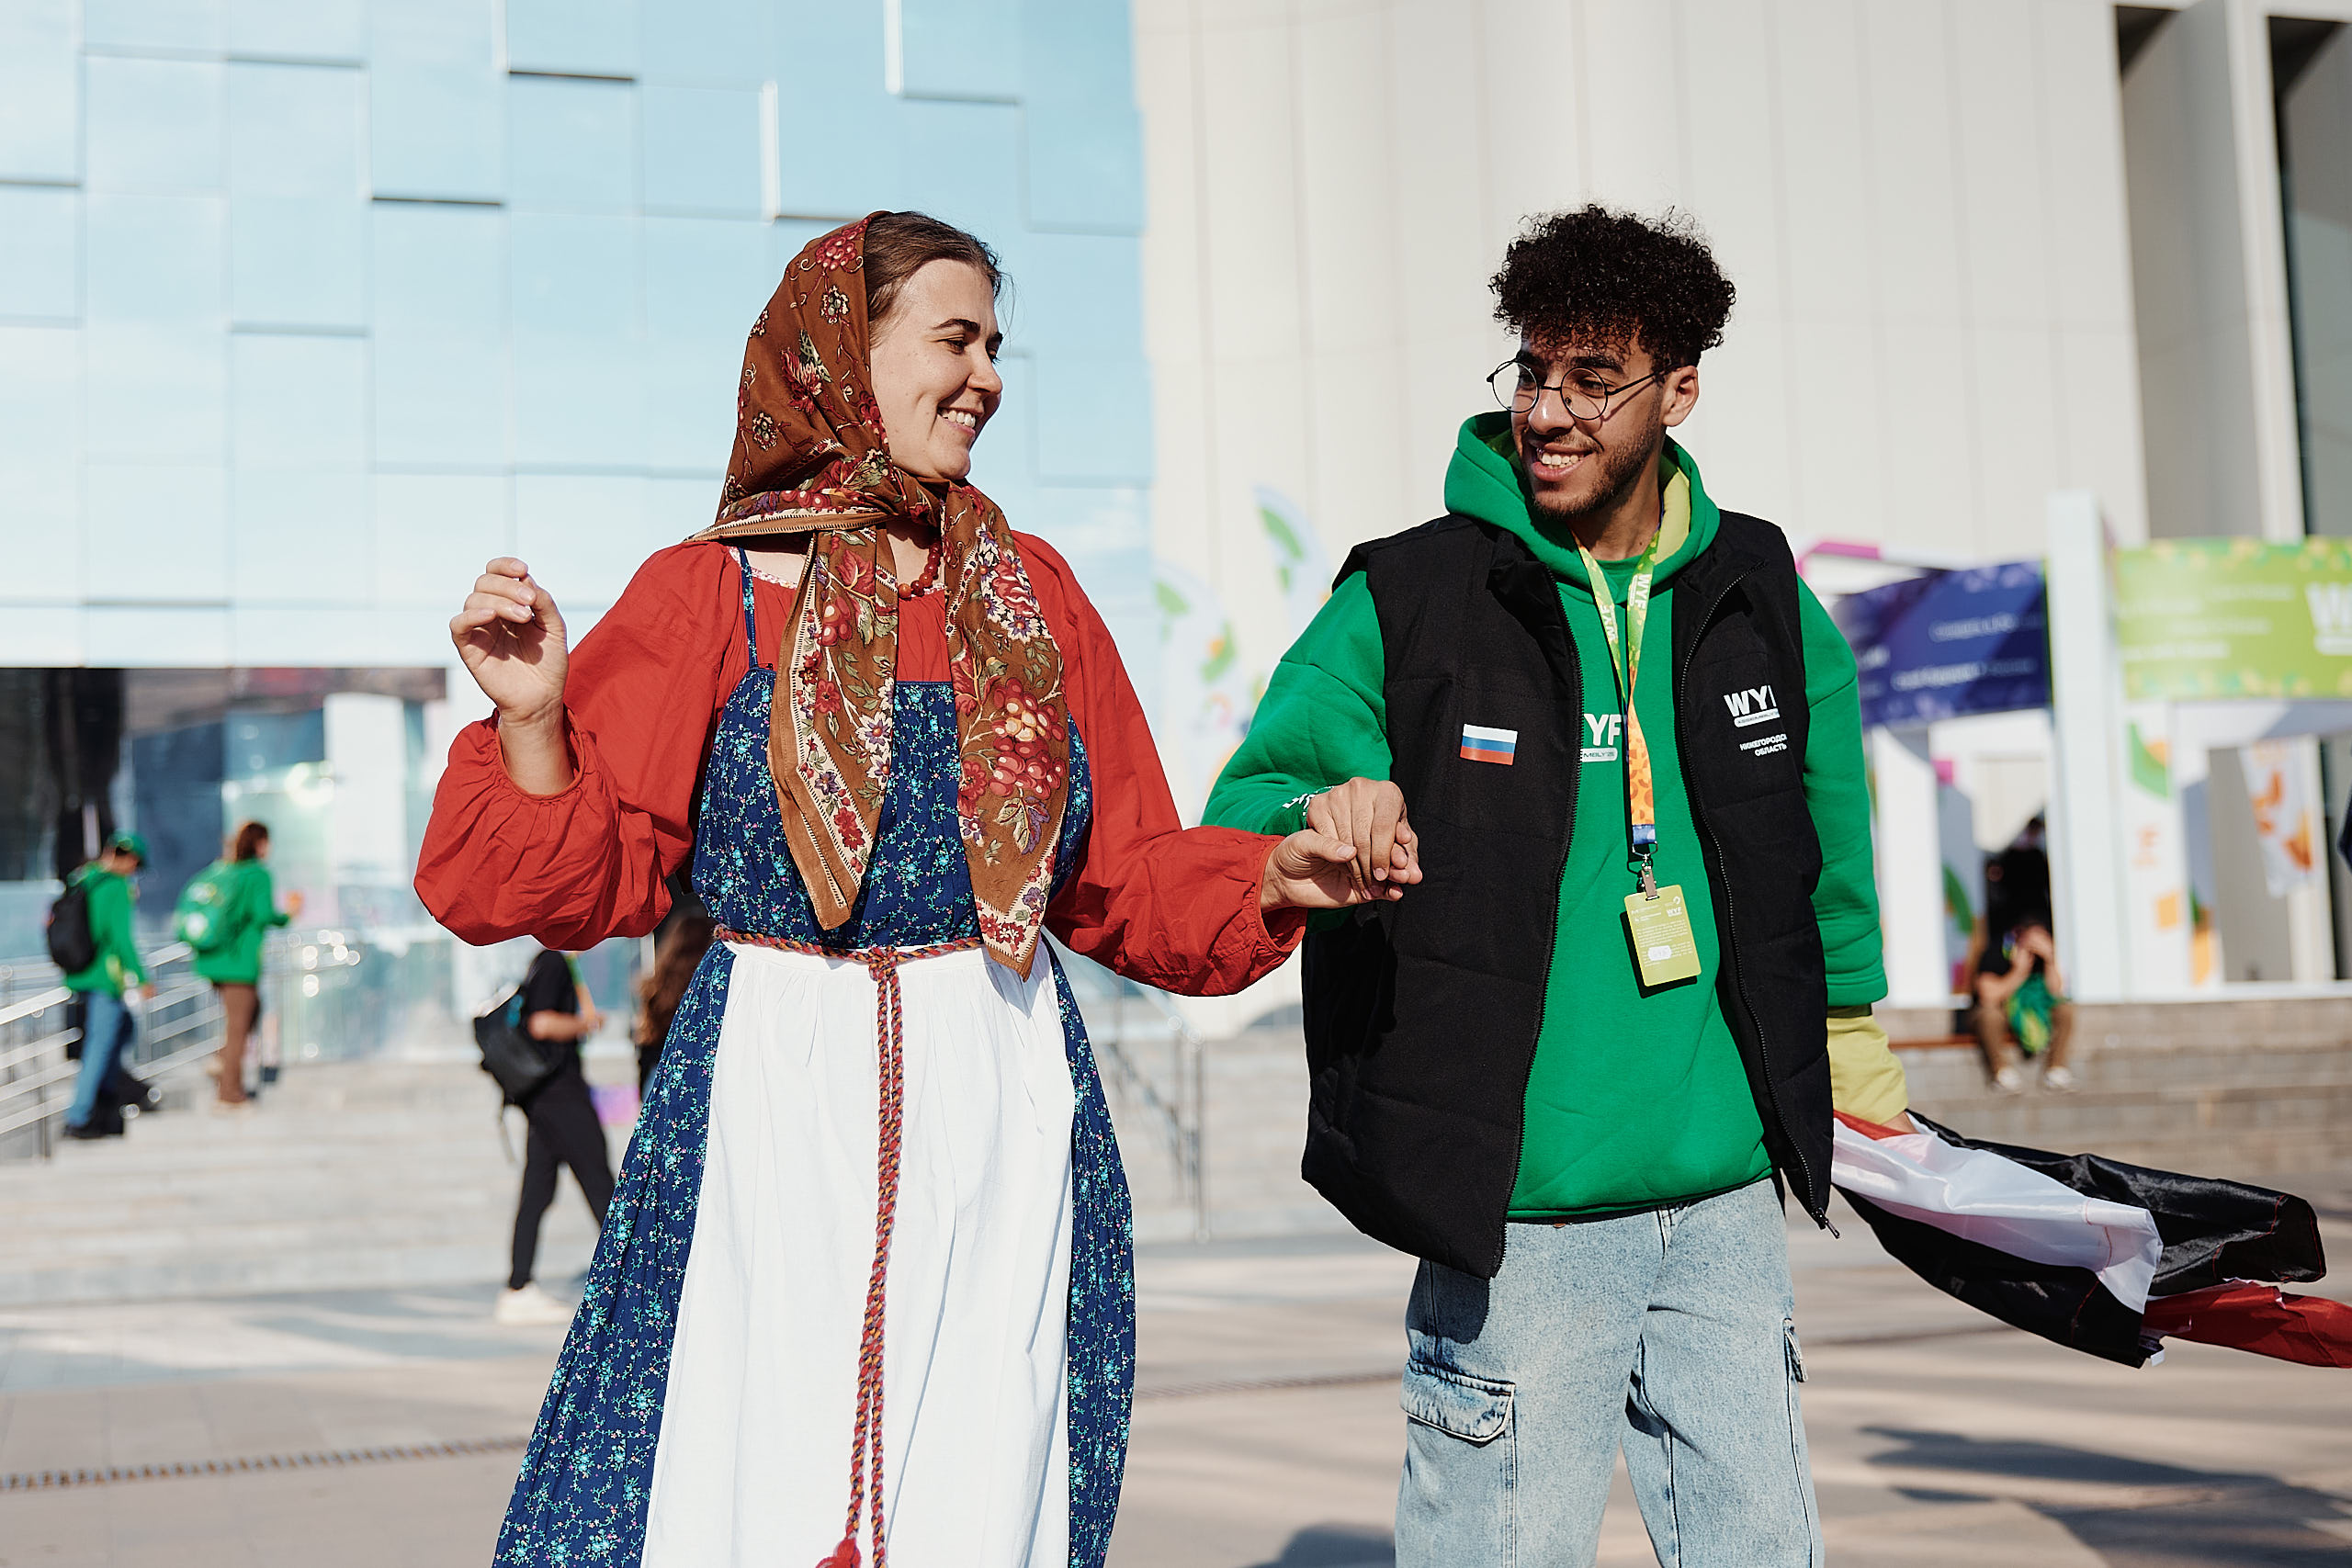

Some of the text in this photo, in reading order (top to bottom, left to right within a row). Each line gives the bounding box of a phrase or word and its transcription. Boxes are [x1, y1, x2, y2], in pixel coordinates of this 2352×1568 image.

[1635, 574, 1652, 610] WYF
[1600, 604, 1616, 641] WYF
[1724, 685, 1777, 716] WY
[1583, 713, 1622, 747] YF
